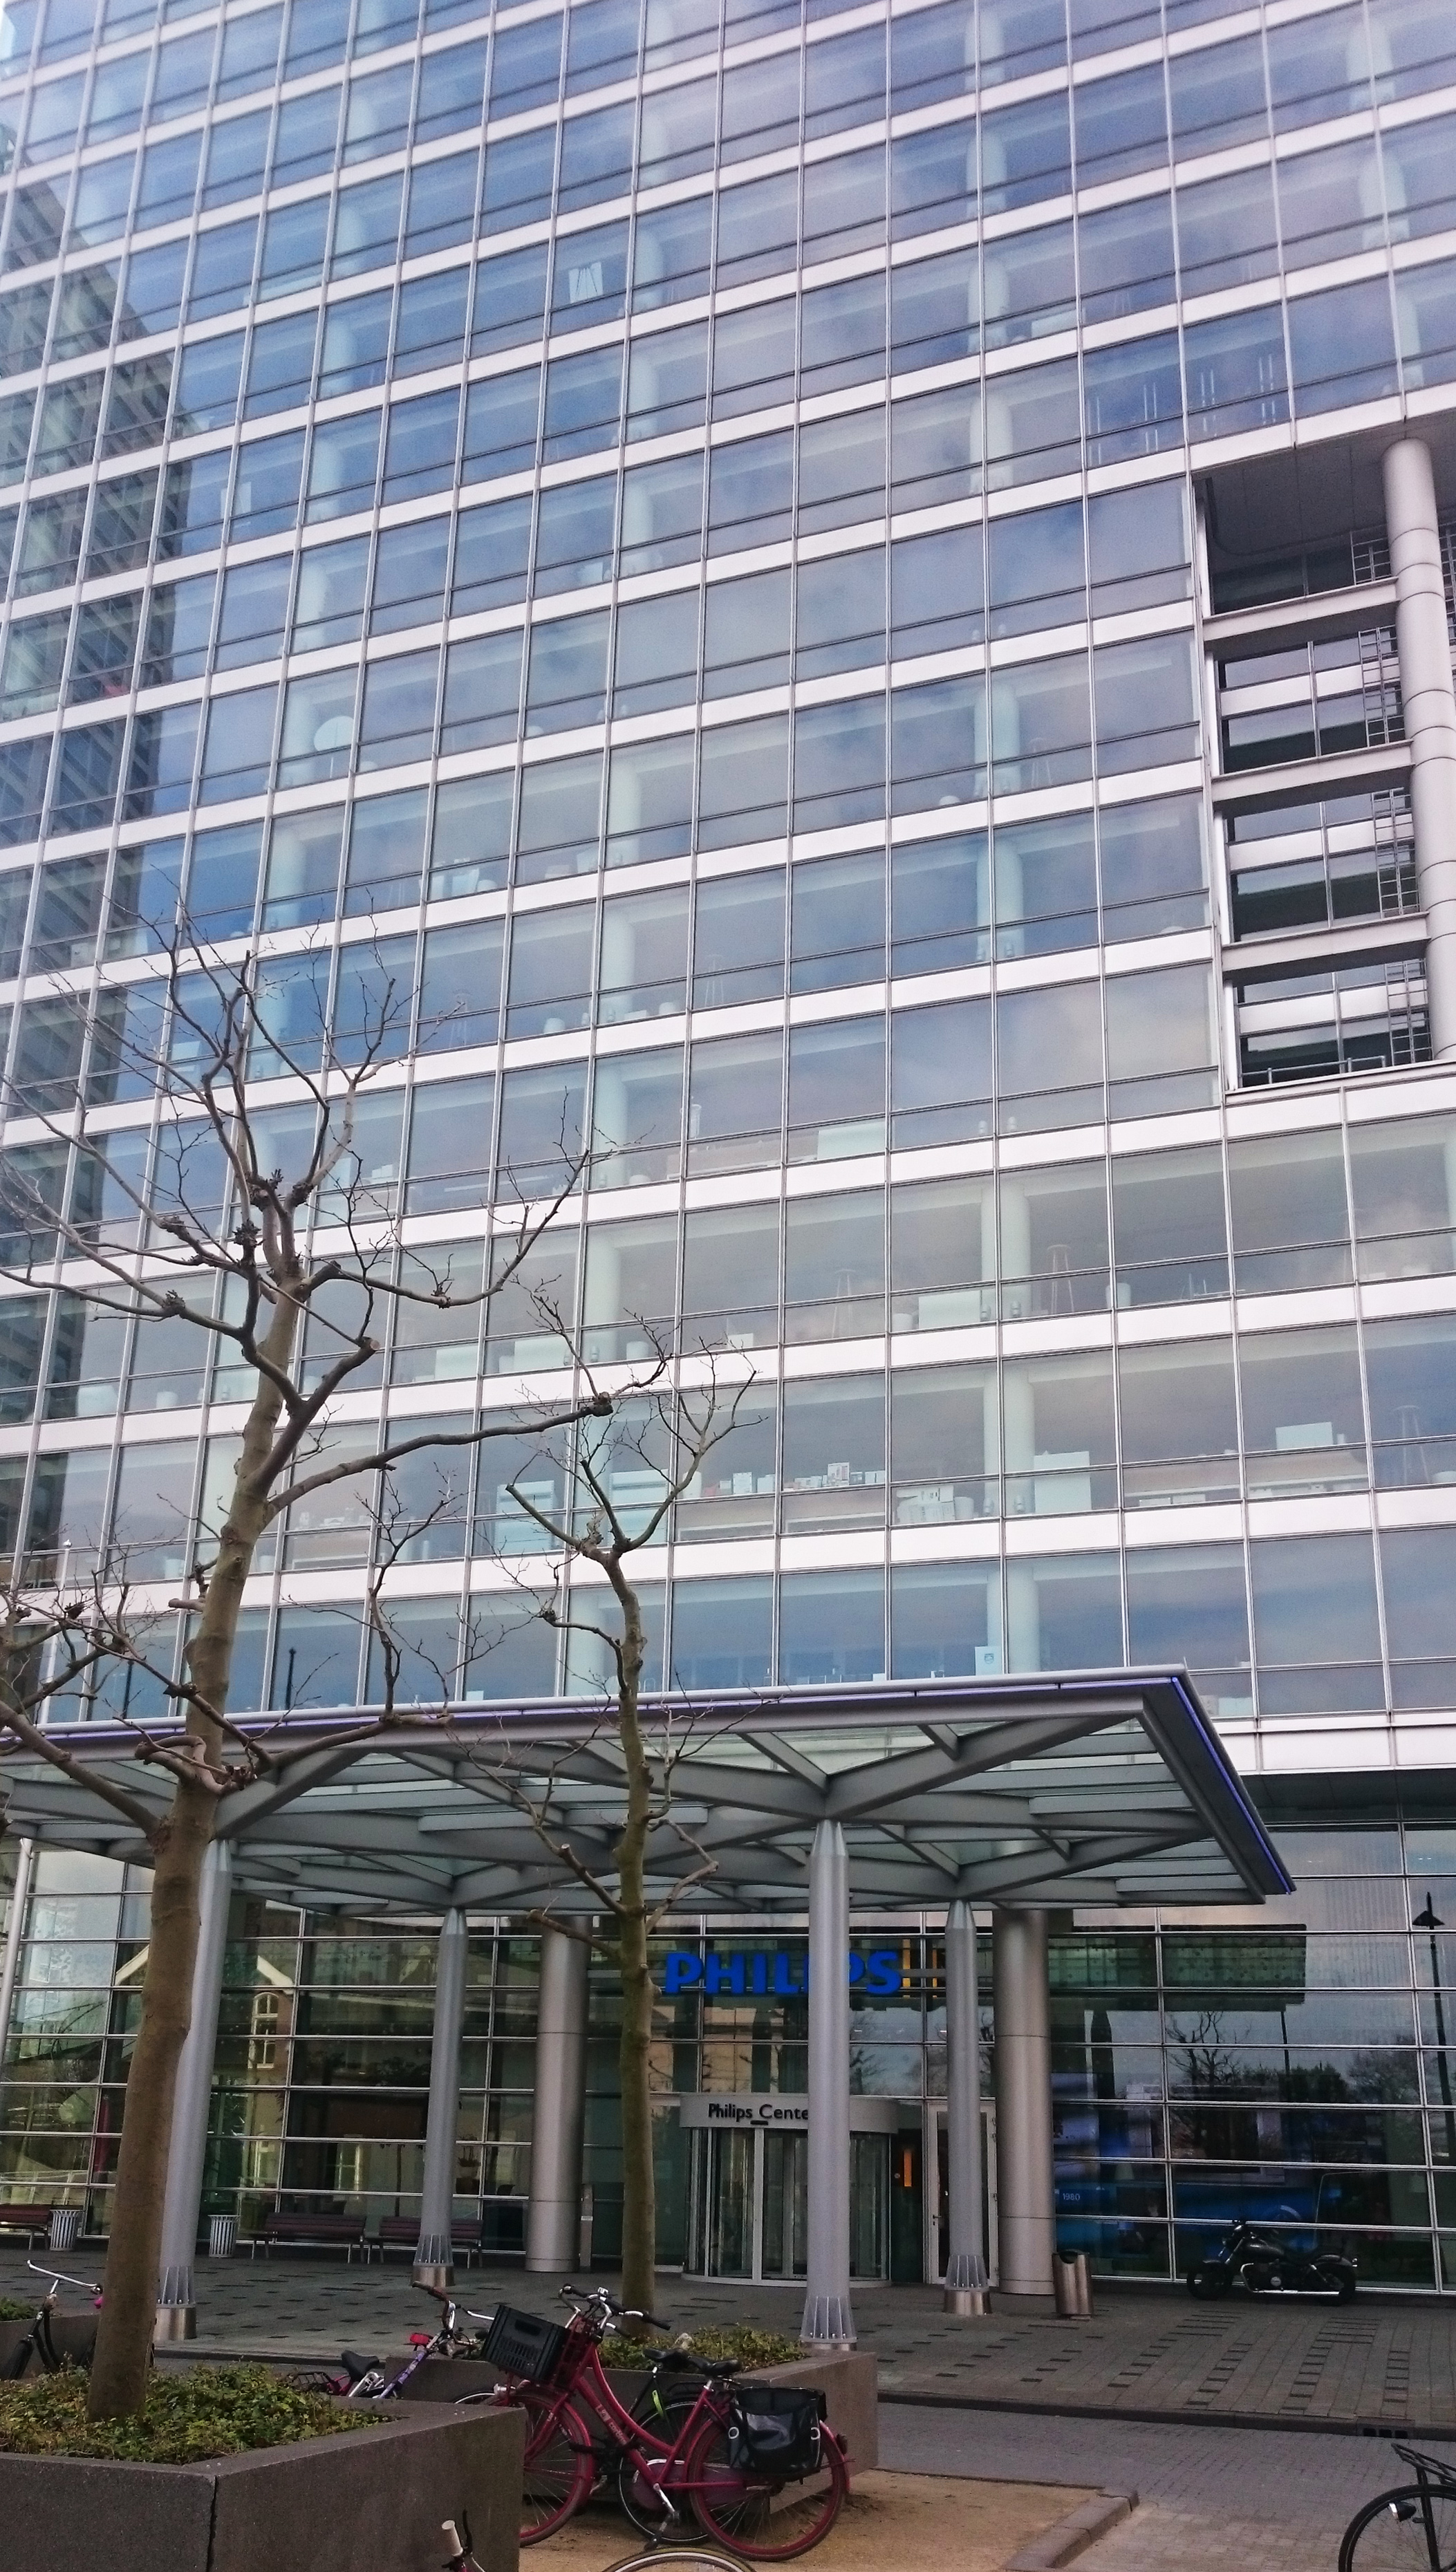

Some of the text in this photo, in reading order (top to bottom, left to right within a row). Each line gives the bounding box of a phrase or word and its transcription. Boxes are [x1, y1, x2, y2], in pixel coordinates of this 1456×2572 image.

[709, 2103, 808, 2122] Philips Cente
[1063, 2192, 1081, 2201] 1980
